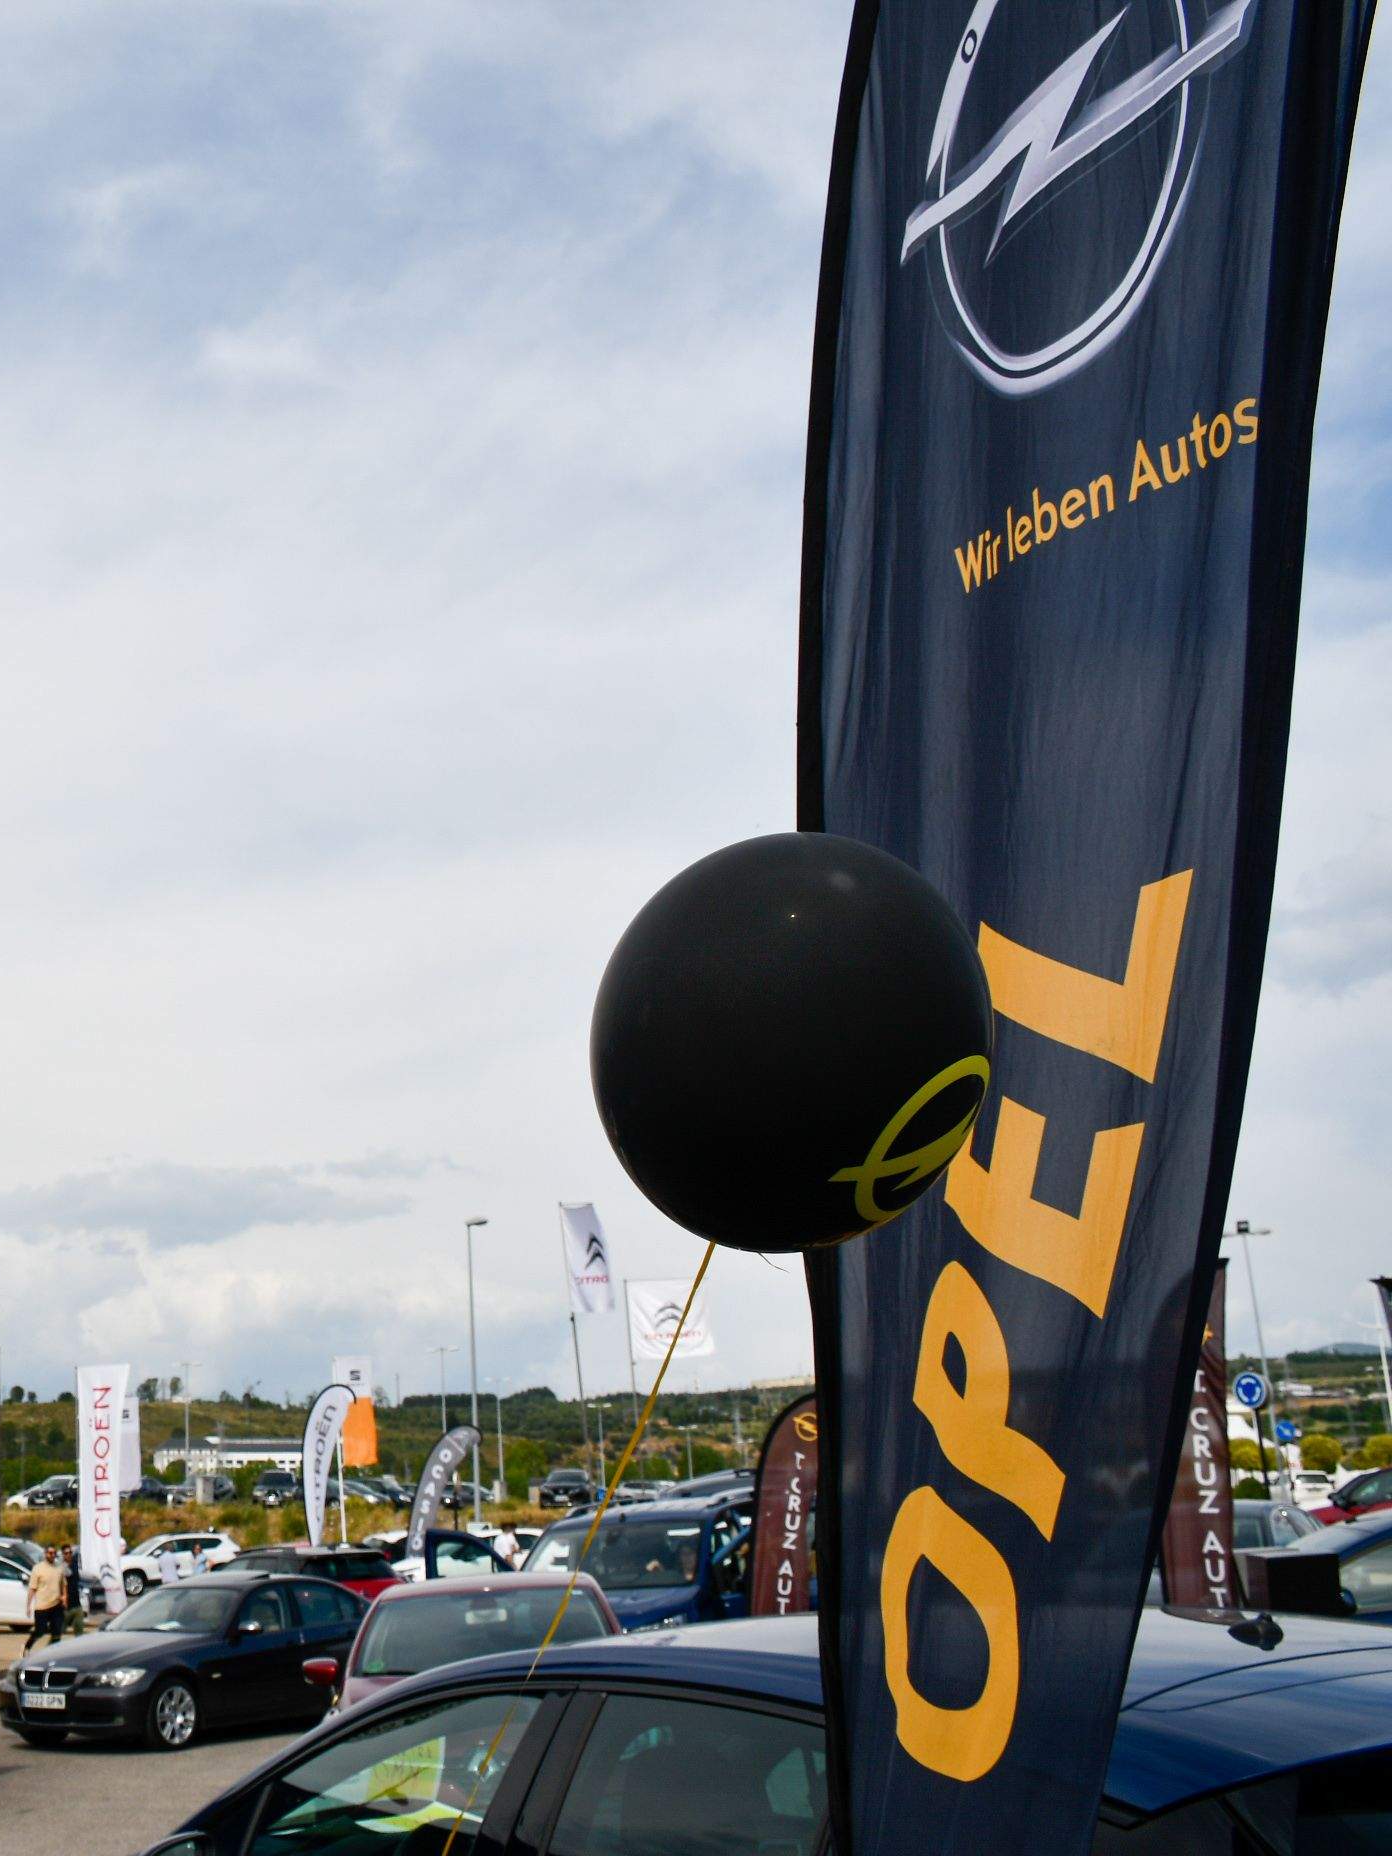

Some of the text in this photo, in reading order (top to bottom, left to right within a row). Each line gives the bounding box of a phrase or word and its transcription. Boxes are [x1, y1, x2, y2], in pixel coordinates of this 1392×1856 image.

[954, 397, 1259, 594] Wir leben Autos
[881, 868, 1194, 1782] OPEL
[89, 1384, 112, 1538] CITROËN
[781, 1476, 803, 1551] CRUZ
[1189, 1407, 1221, 1516] CRUZ
[776, 1559, 794, 1616] AUT
[1202, 1530, 1228, 1611] AUT
